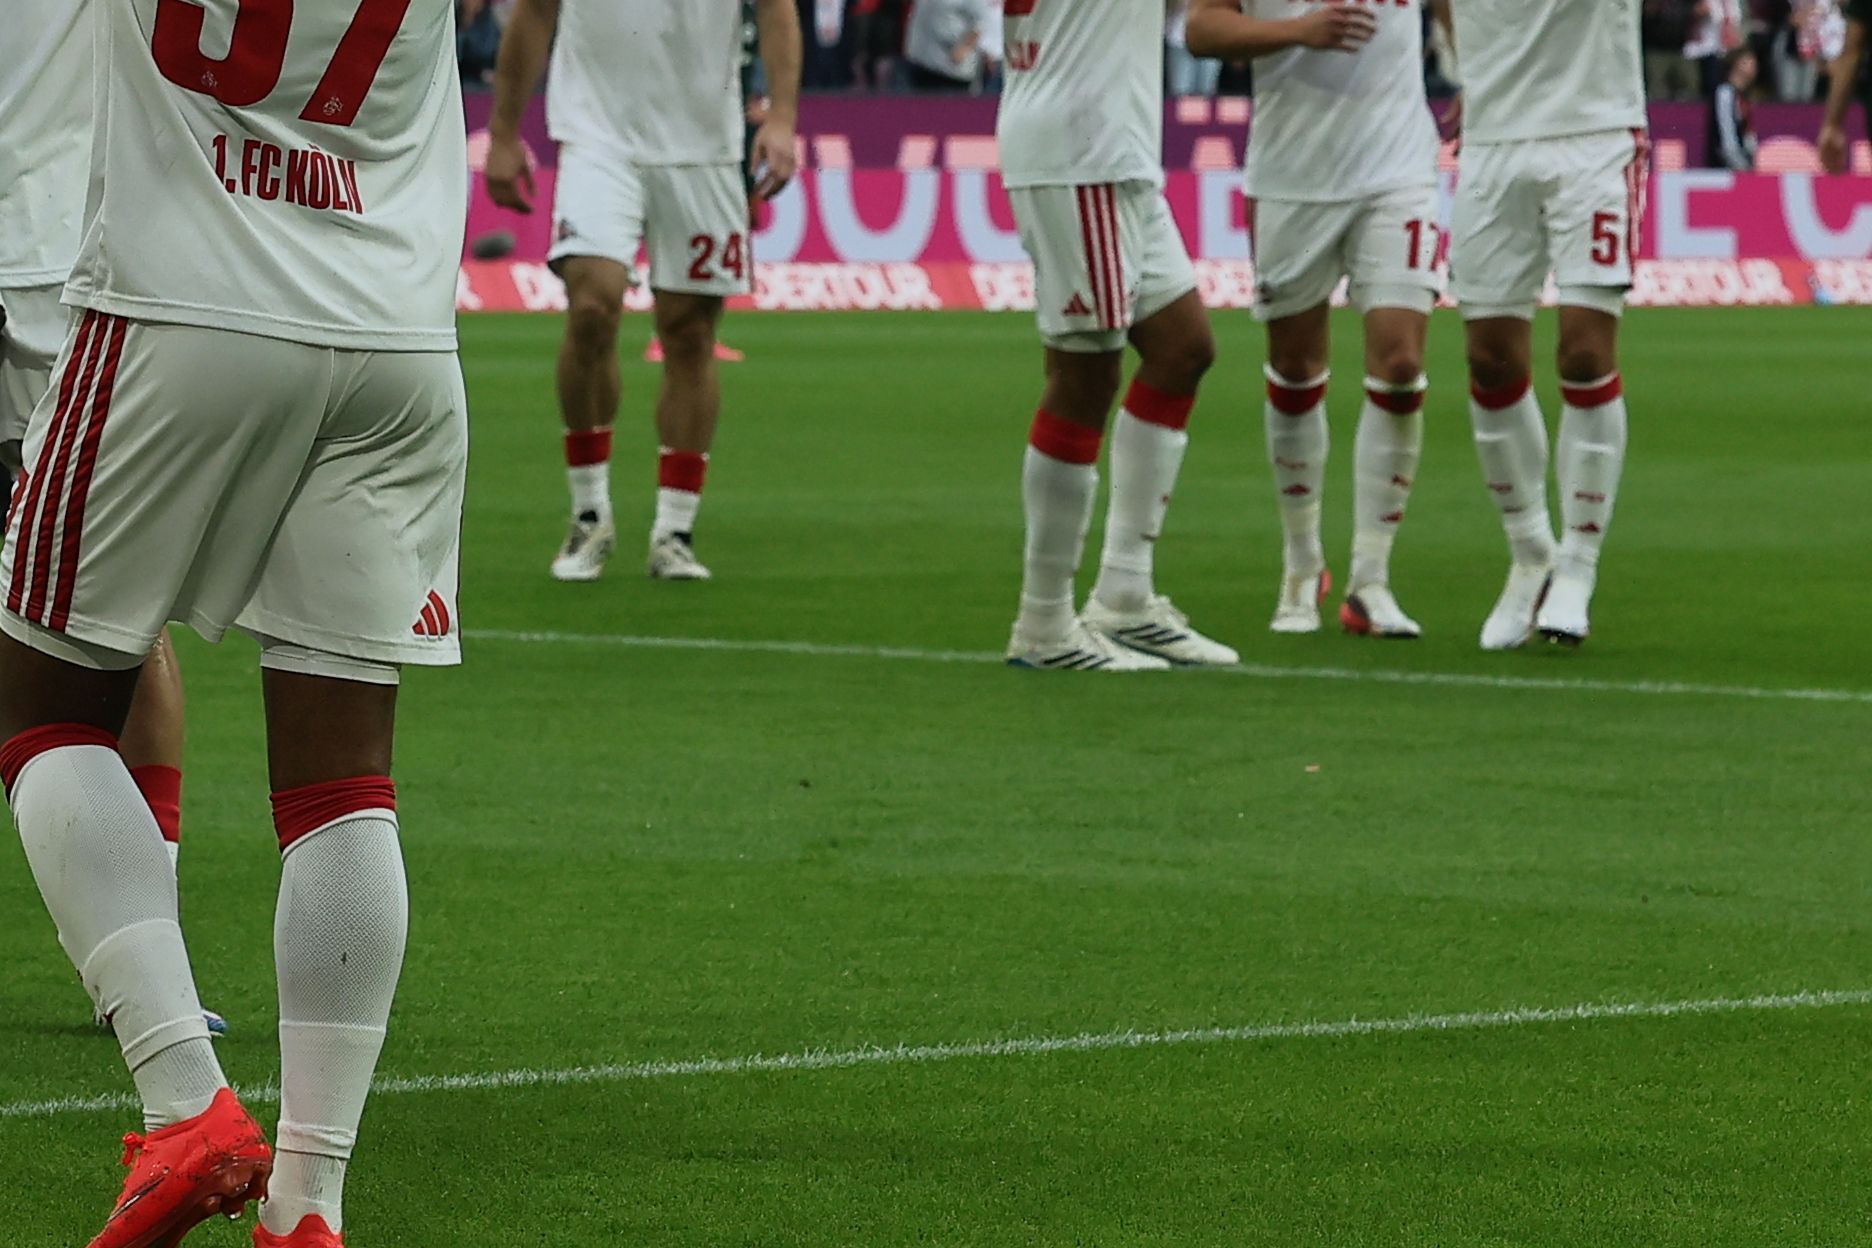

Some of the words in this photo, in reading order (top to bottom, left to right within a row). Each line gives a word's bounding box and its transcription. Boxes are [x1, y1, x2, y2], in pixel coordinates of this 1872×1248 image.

[242, 139, 281, 200] FC
[285, 142, 363, 215] KÖLN
[689, 234, 745, 281] 24
[1591, 213, 1619, 265] 5
